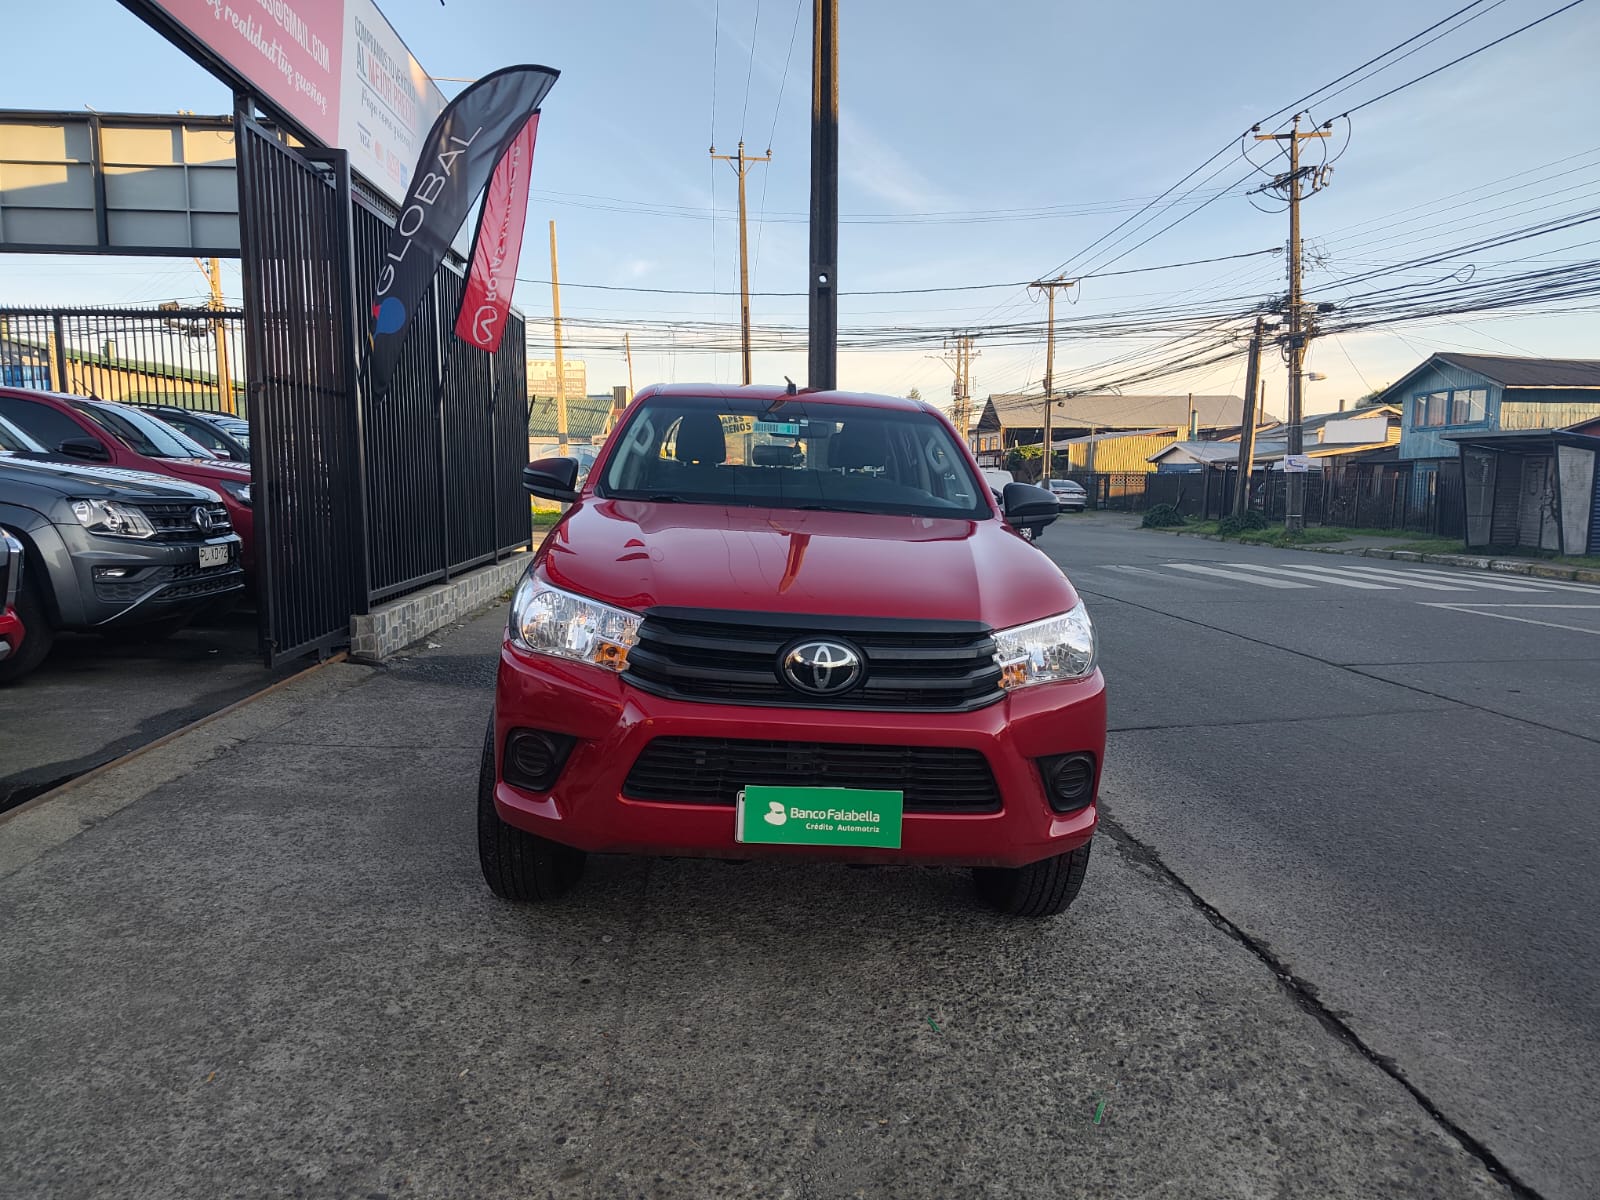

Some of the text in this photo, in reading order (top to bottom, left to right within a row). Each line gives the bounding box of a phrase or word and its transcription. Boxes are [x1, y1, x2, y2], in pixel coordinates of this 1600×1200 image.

[224, 5, 277, 64] realidad
[276, 42, 295, 85] tus
[294, 71, 328, 116] sueños
[356, 41, 367, 78] AL
[376, 126, 482, 296] GLOBAL
[837, 823, 881, 833] Automotriz
